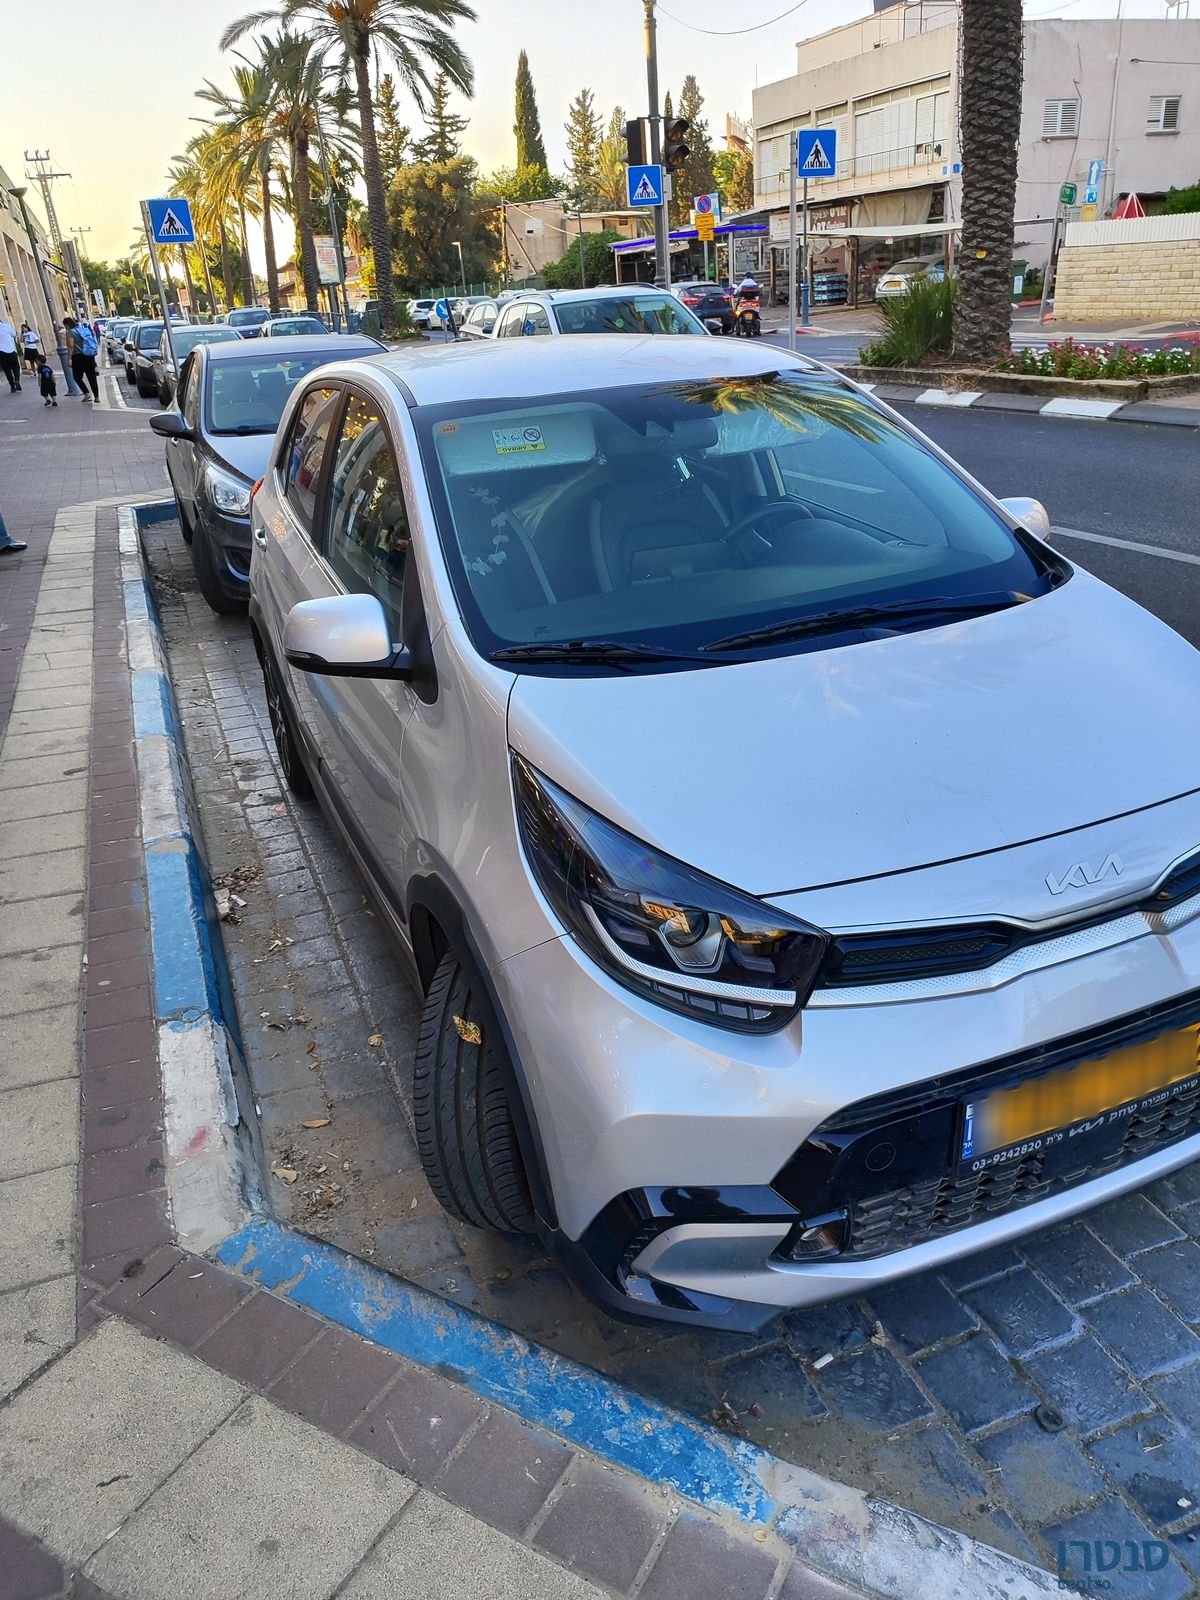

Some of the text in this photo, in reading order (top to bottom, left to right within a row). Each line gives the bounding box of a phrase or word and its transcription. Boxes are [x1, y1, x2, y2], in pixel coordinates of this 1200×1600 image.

[1044, 852, 1124, 895] KIA
[1172, 1079, 1198, 1095] שירות
[1109, 1103, 1138, 1122] שחק
[1068, 1116, 1105, 1138] KIA
[972, 1140, 1042, 1171] 03-9242820
